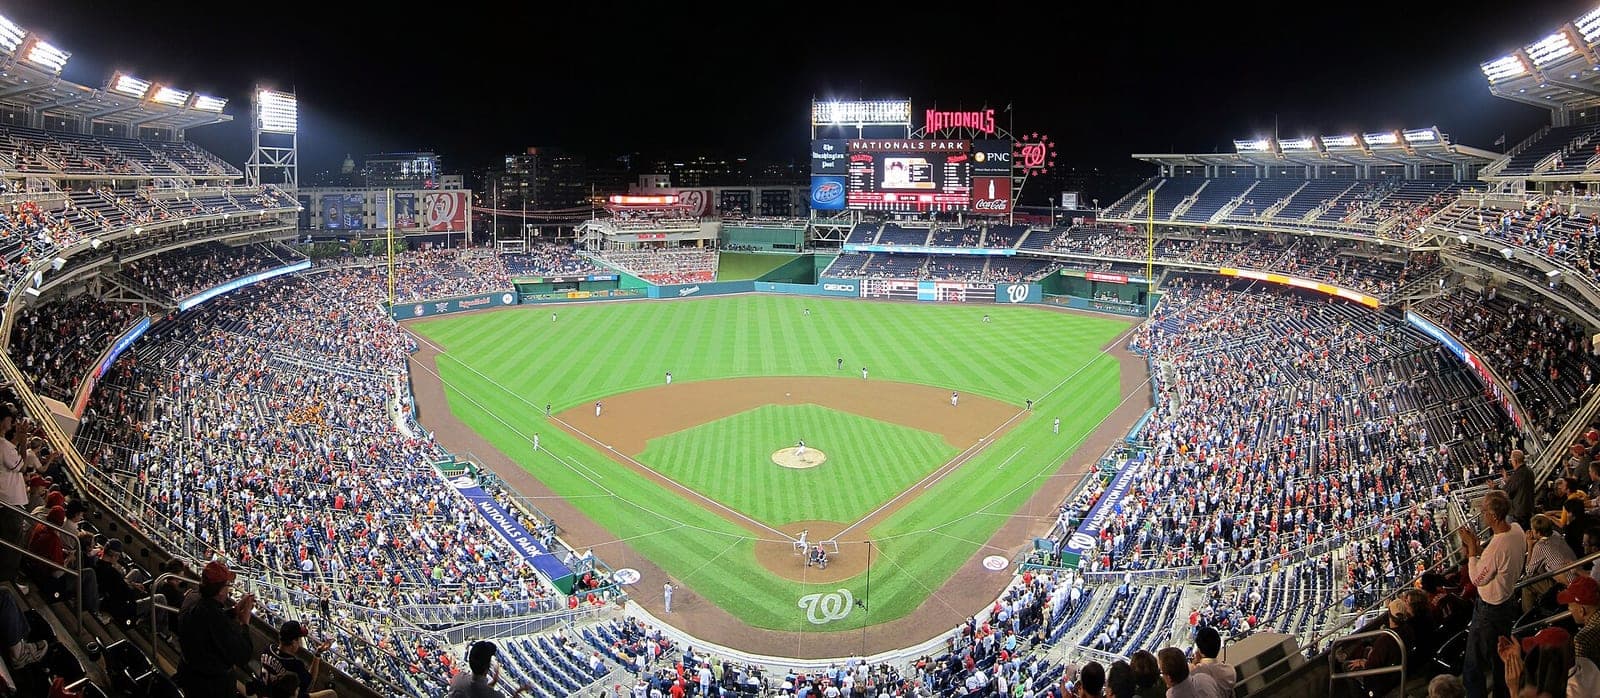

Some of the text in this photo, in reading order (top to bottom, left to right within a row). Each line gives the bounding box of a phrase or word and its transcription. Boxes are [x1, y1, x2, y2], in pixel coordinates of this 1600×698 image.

[926, 109, 994, 134] NATIONALS
[823, 143, 834, 151] The
[853, 142, 963, 150] NATIONALS PARK
[812, 151, 845, 160] Washington
[987, 152, 1010, 162] PNC
[1022, 141, 1046, 167] W
[822, 161, 835, 169] Post
[823, 283, 854, 292] GEICO
[1006, 283, 1029, 303] W
[1085, 489, 1121, 531] WASHINGTON
[478, 501, 543, 557] NATIONALS PARK
[798, 588, 853, 624] W
